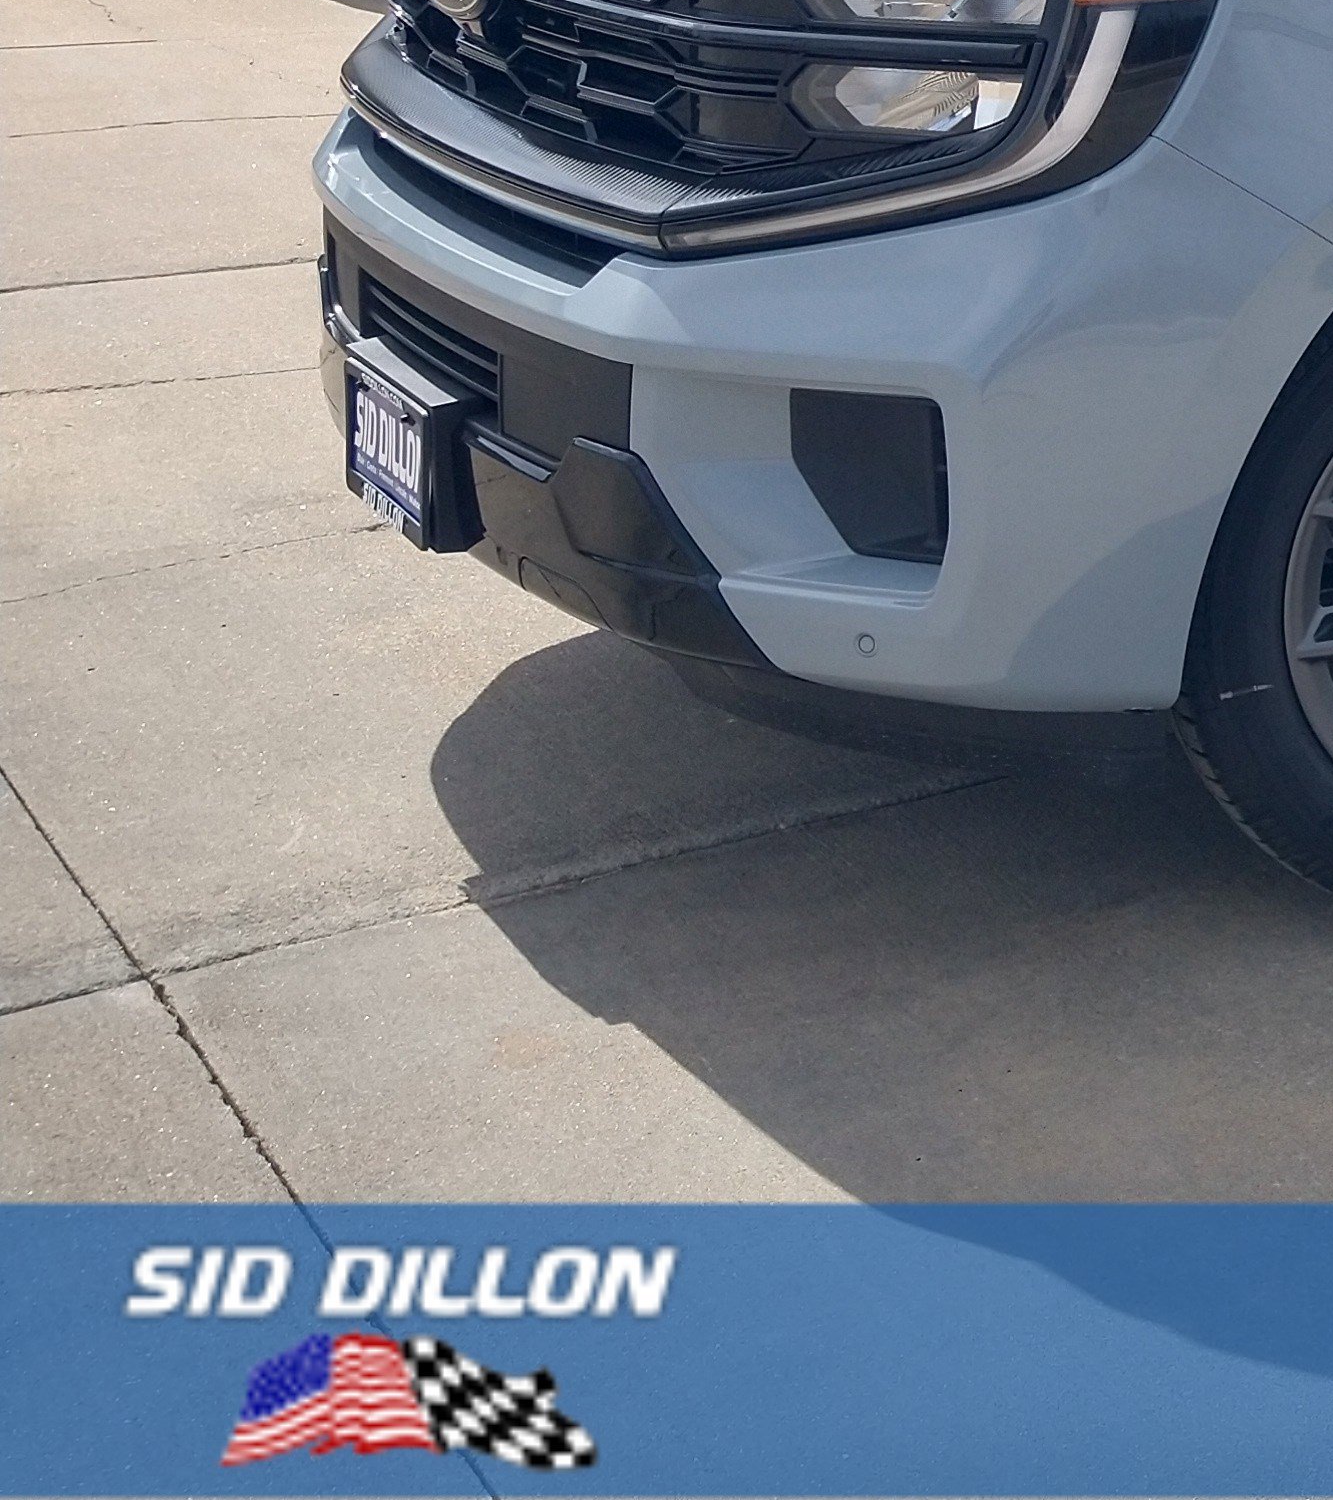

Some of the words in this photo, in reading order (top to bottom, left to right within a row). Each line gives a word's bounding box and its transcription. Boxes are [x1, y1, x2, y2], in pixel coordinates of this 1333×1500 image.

[354, 391, 377, 459] SID
[362, 482, 375, 509] SID
[376, 493, 405, 534] DILLON
